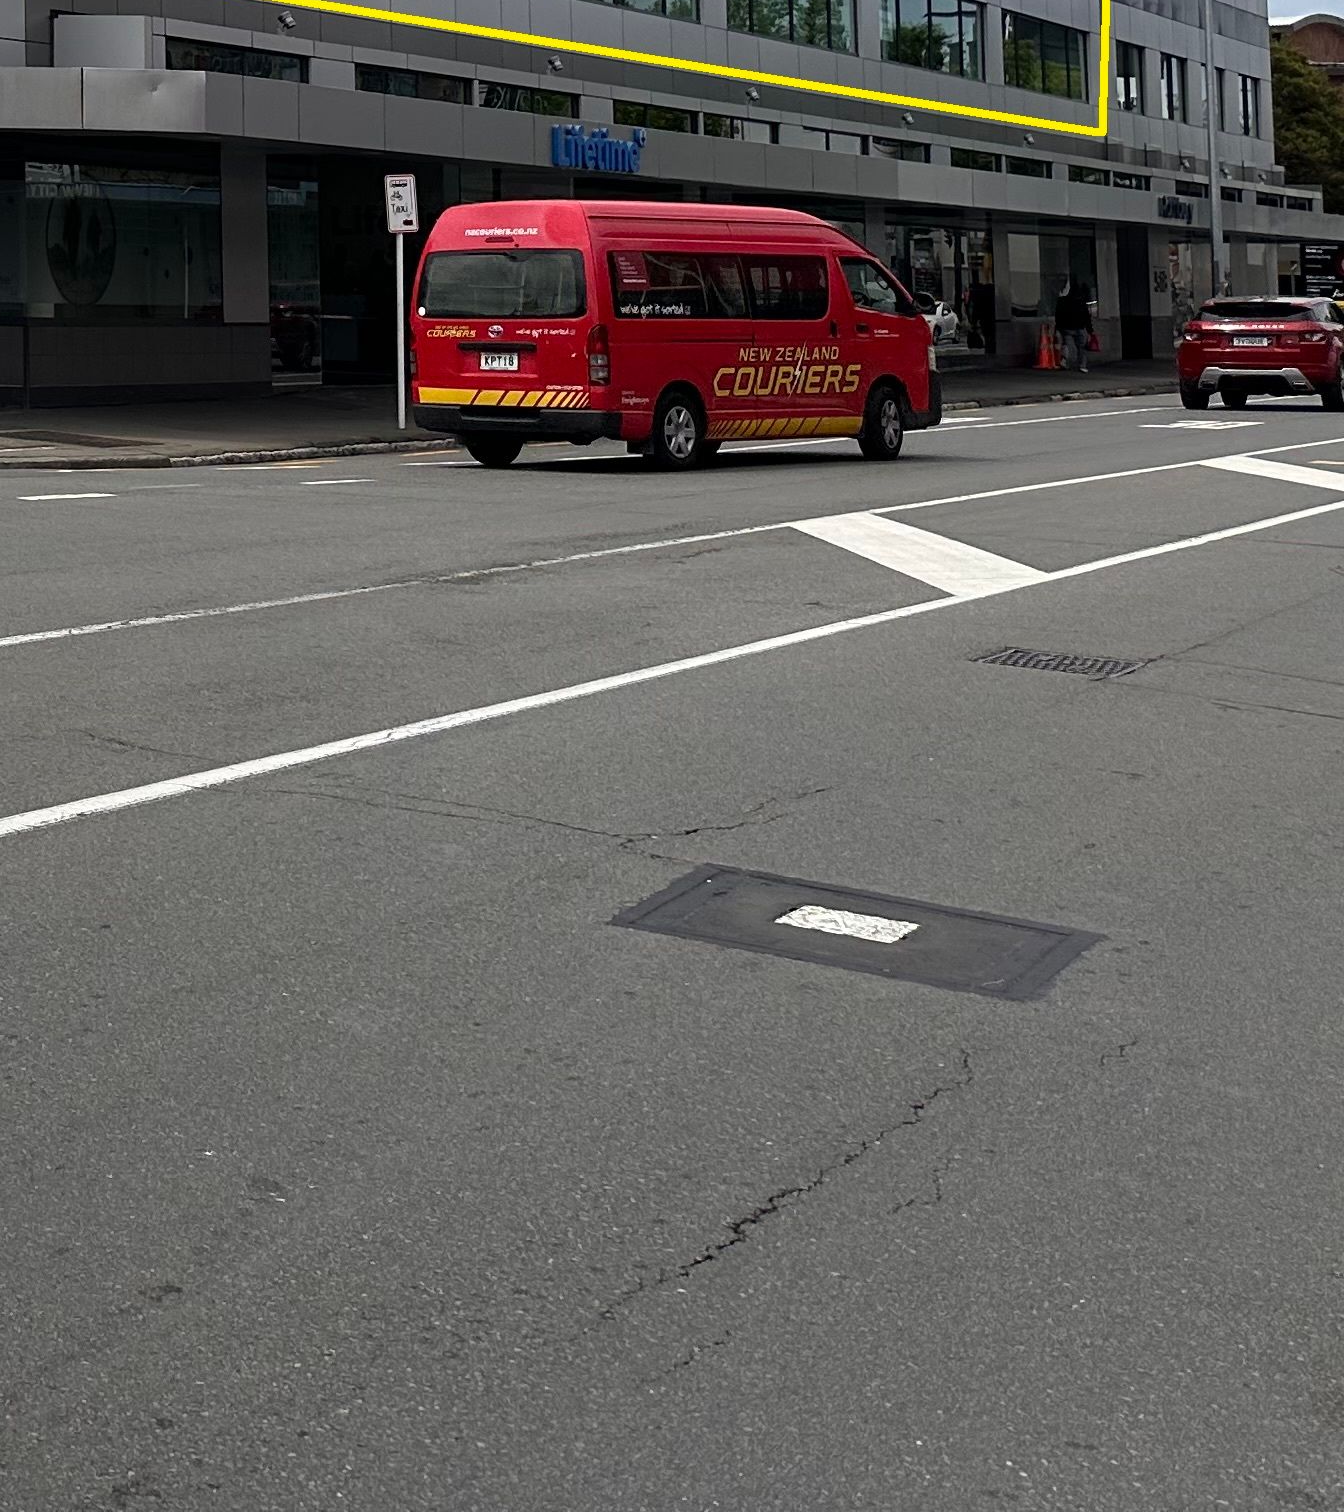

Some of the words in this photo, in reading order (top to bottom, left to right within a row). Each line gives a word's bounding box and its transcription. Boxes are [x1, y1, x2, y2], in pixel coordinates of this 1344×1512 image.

[551, 124, 641, 173] Lifetime
[739, 347, 772, 361] NEW
[775, 346, 839, 361] ZEALAND
[713, 364, 861, 397] COURIERS
